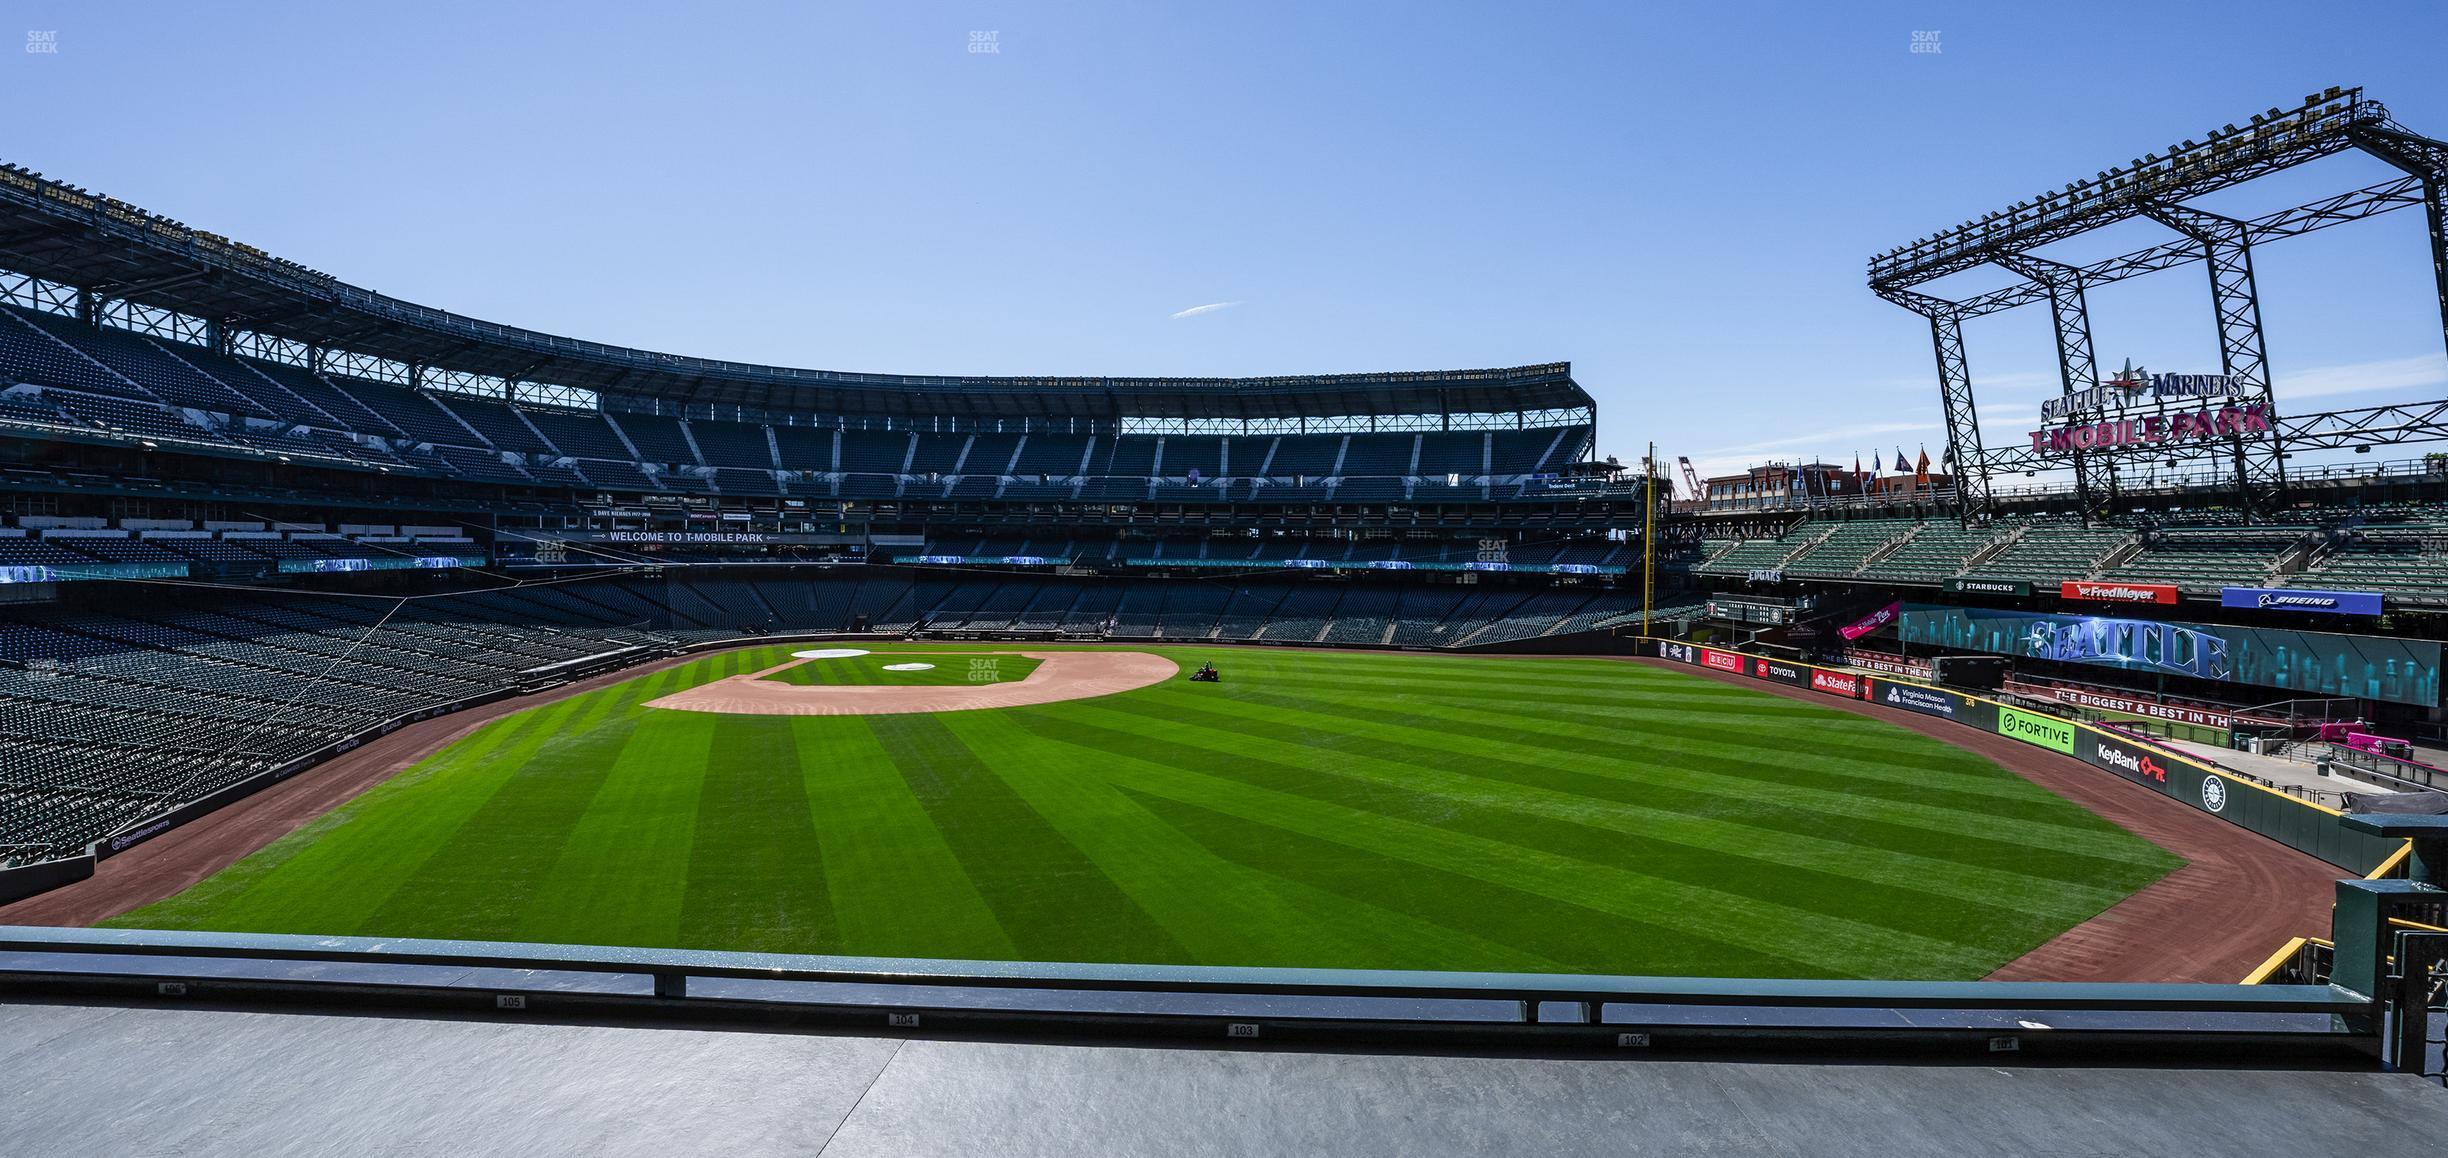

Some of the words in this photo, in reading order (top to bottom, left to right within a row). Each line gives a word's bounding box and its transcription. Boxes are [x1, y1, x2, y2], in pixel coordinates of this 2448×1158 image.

[2041, 385, 2110, 422] SEATTLE
[2151, 371, 2246, 398] MARINERS
[2029, 414, 2167, 454] T-MOBILE
[2170, 400, 2276, 441] PARK
[610, 532, 664, 542] WELCOME
[667, 532, 682, 542] TO
[685, 532, 733, 542] T-MOBILE
[735, 533, 763, 542] PARK
[1966, 583, 2013, 592] STARBUCKS
[2275, 596, 2335, 606] BOEING
[1710, 655, 1734, 667] BECU
[1769, 665, 1796, 679] TOYOTA
[1866, 661, 1873, 669] &
[1874, 662, 1893, 673] BEST
[1894, 666, 1903, 674] IN
[1905, 667, 1920, 676] THE
[1902, 689, 1924, 699] Virginia
[1925, 694, 1946, 703] Mason
[1902, 697, 1933, 709] Franciscan
[1934, 703, 1953, 714] Health
[2080, 694, 2133, 712] BIGGEST
[2136, 704, 2145, 714] &
[2150, 705, 2185, 720] BEST
[2189, 712, 2203, 723] IN
[2018, 720, 2069, 745] FORTIVE
[2098, 743, 2140, 773] KeyBank
[503, 997, 521, 1007] 105
[895, 1015, 914, 1025] 104
[1234, 1026, 1253, 1036] 103
[1624, 1035, 1643, 1046] 102
